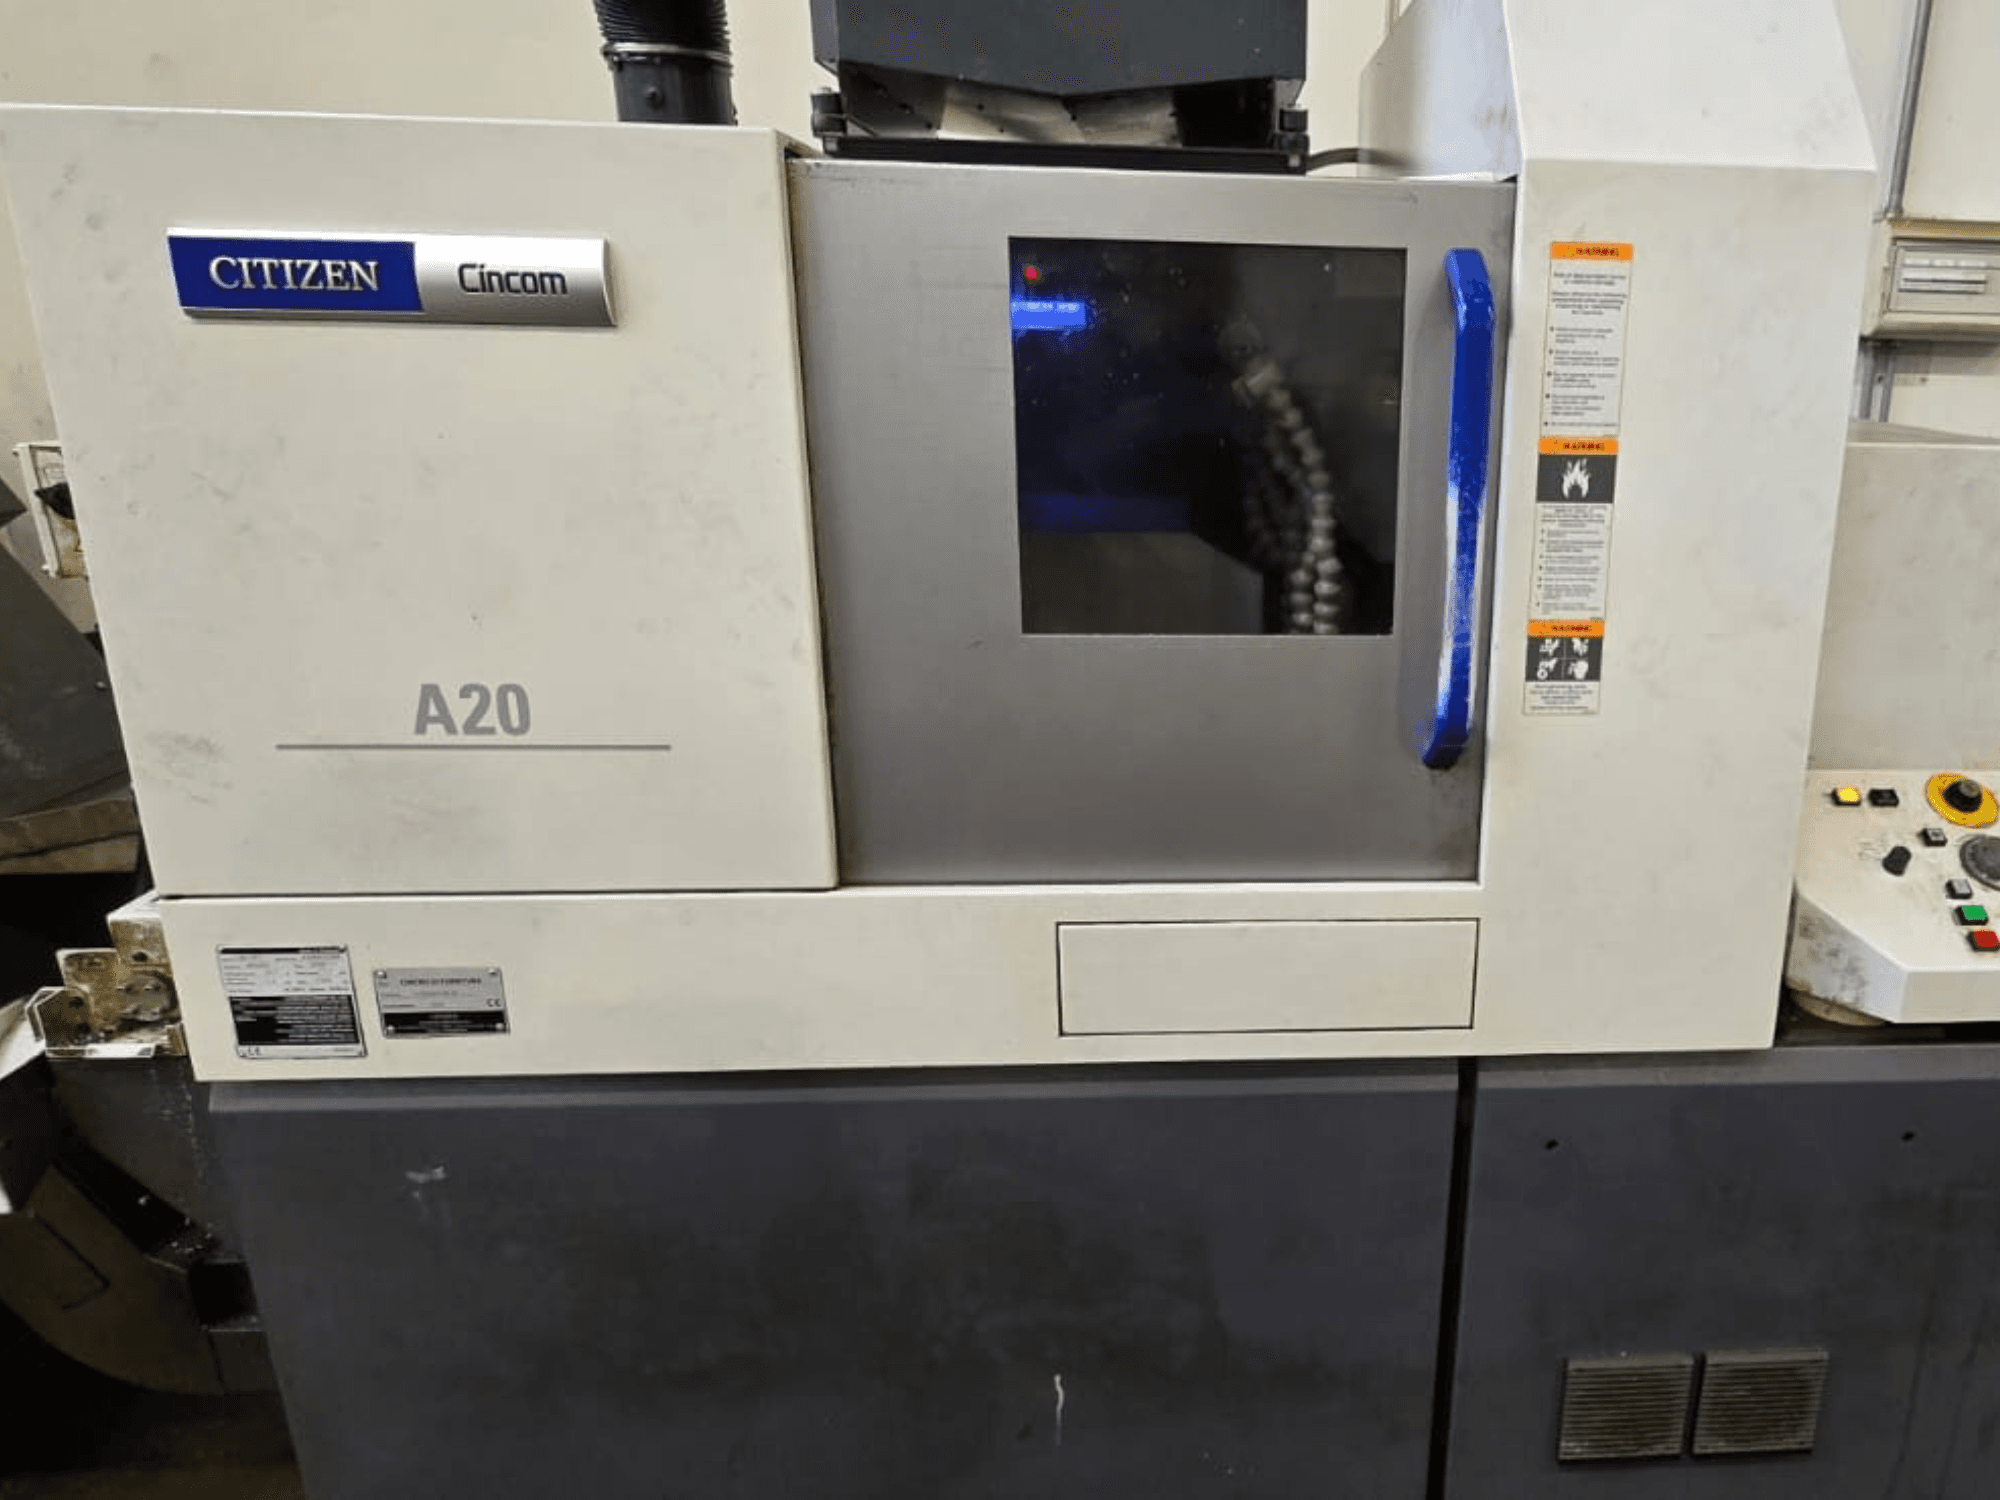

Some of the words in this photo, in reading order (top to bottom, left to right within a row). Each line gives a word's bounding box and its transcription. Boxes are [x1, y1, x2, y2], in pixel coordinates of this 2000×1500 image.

[209, 255, 379, 292] CITIZEN
[458, 262, 568, 295] Cincom
[414, 683, 531, 735] A20
